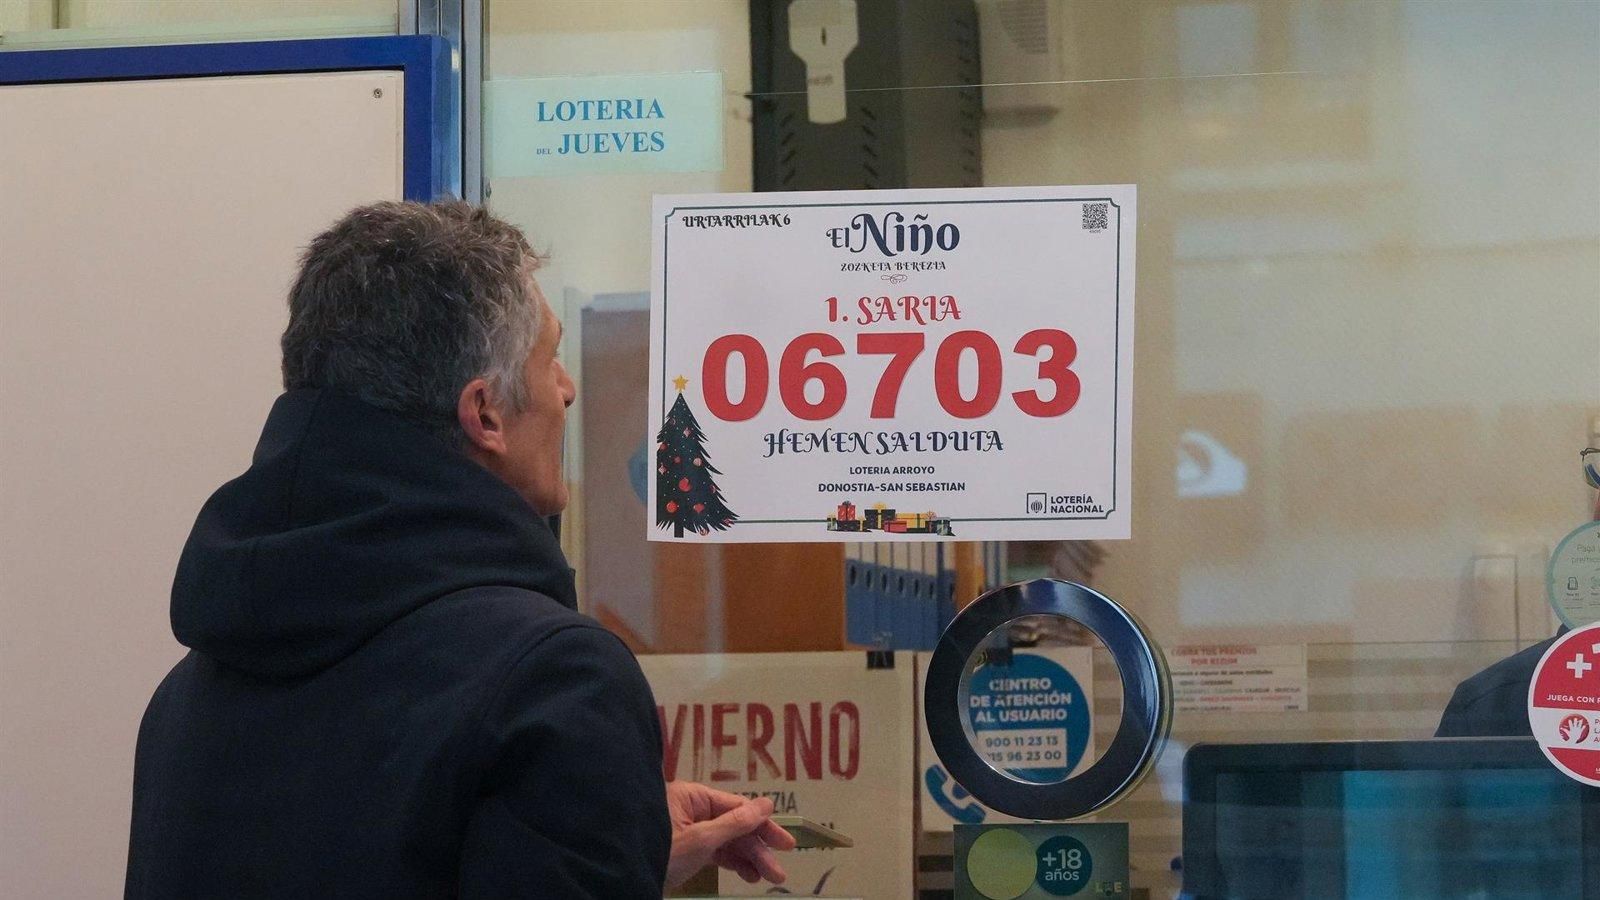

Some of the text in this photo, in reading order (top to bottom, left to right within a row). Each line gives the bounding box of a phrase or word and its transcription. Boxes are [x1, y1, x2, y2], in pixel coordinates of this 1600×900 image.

[537, 98, 665, 122] LOTERIA
[558, 131, 665, 154] JUEVES
[682, 213, 791, 228] URTARRILAK 6
[826, 211, 960, 257] El Niño
[840, 261, 946, 272] ZOZKETA BEREZIA
[824, 295, 962, 326] 1. SARIA
[701, 328, 1082, 422] 06703
[763, 428, 1004, 458] HEMEN SALDUTA
[849, 466, 935, 476] LOTERIA ARROYO
[818, 482, 966, 493] DONOSTIA-SAN SEBASTIAN
[1050, 494, 1094, 505] LOTERÍA
[1050, 504, 1104, 514] NACIONAL
[970, 690, 1072, 708] DE ATENCIÓN
[1547, 694, 1574, 702] JUEGA
[975, 708, 1067, 722] AL USUARIO
[656, 702, 861, 782] VIERNO
[1044, 750, 1062, 761] 00
[1042, 848, 1082, 870] +18
[1045, 869, 1080, 881] años
